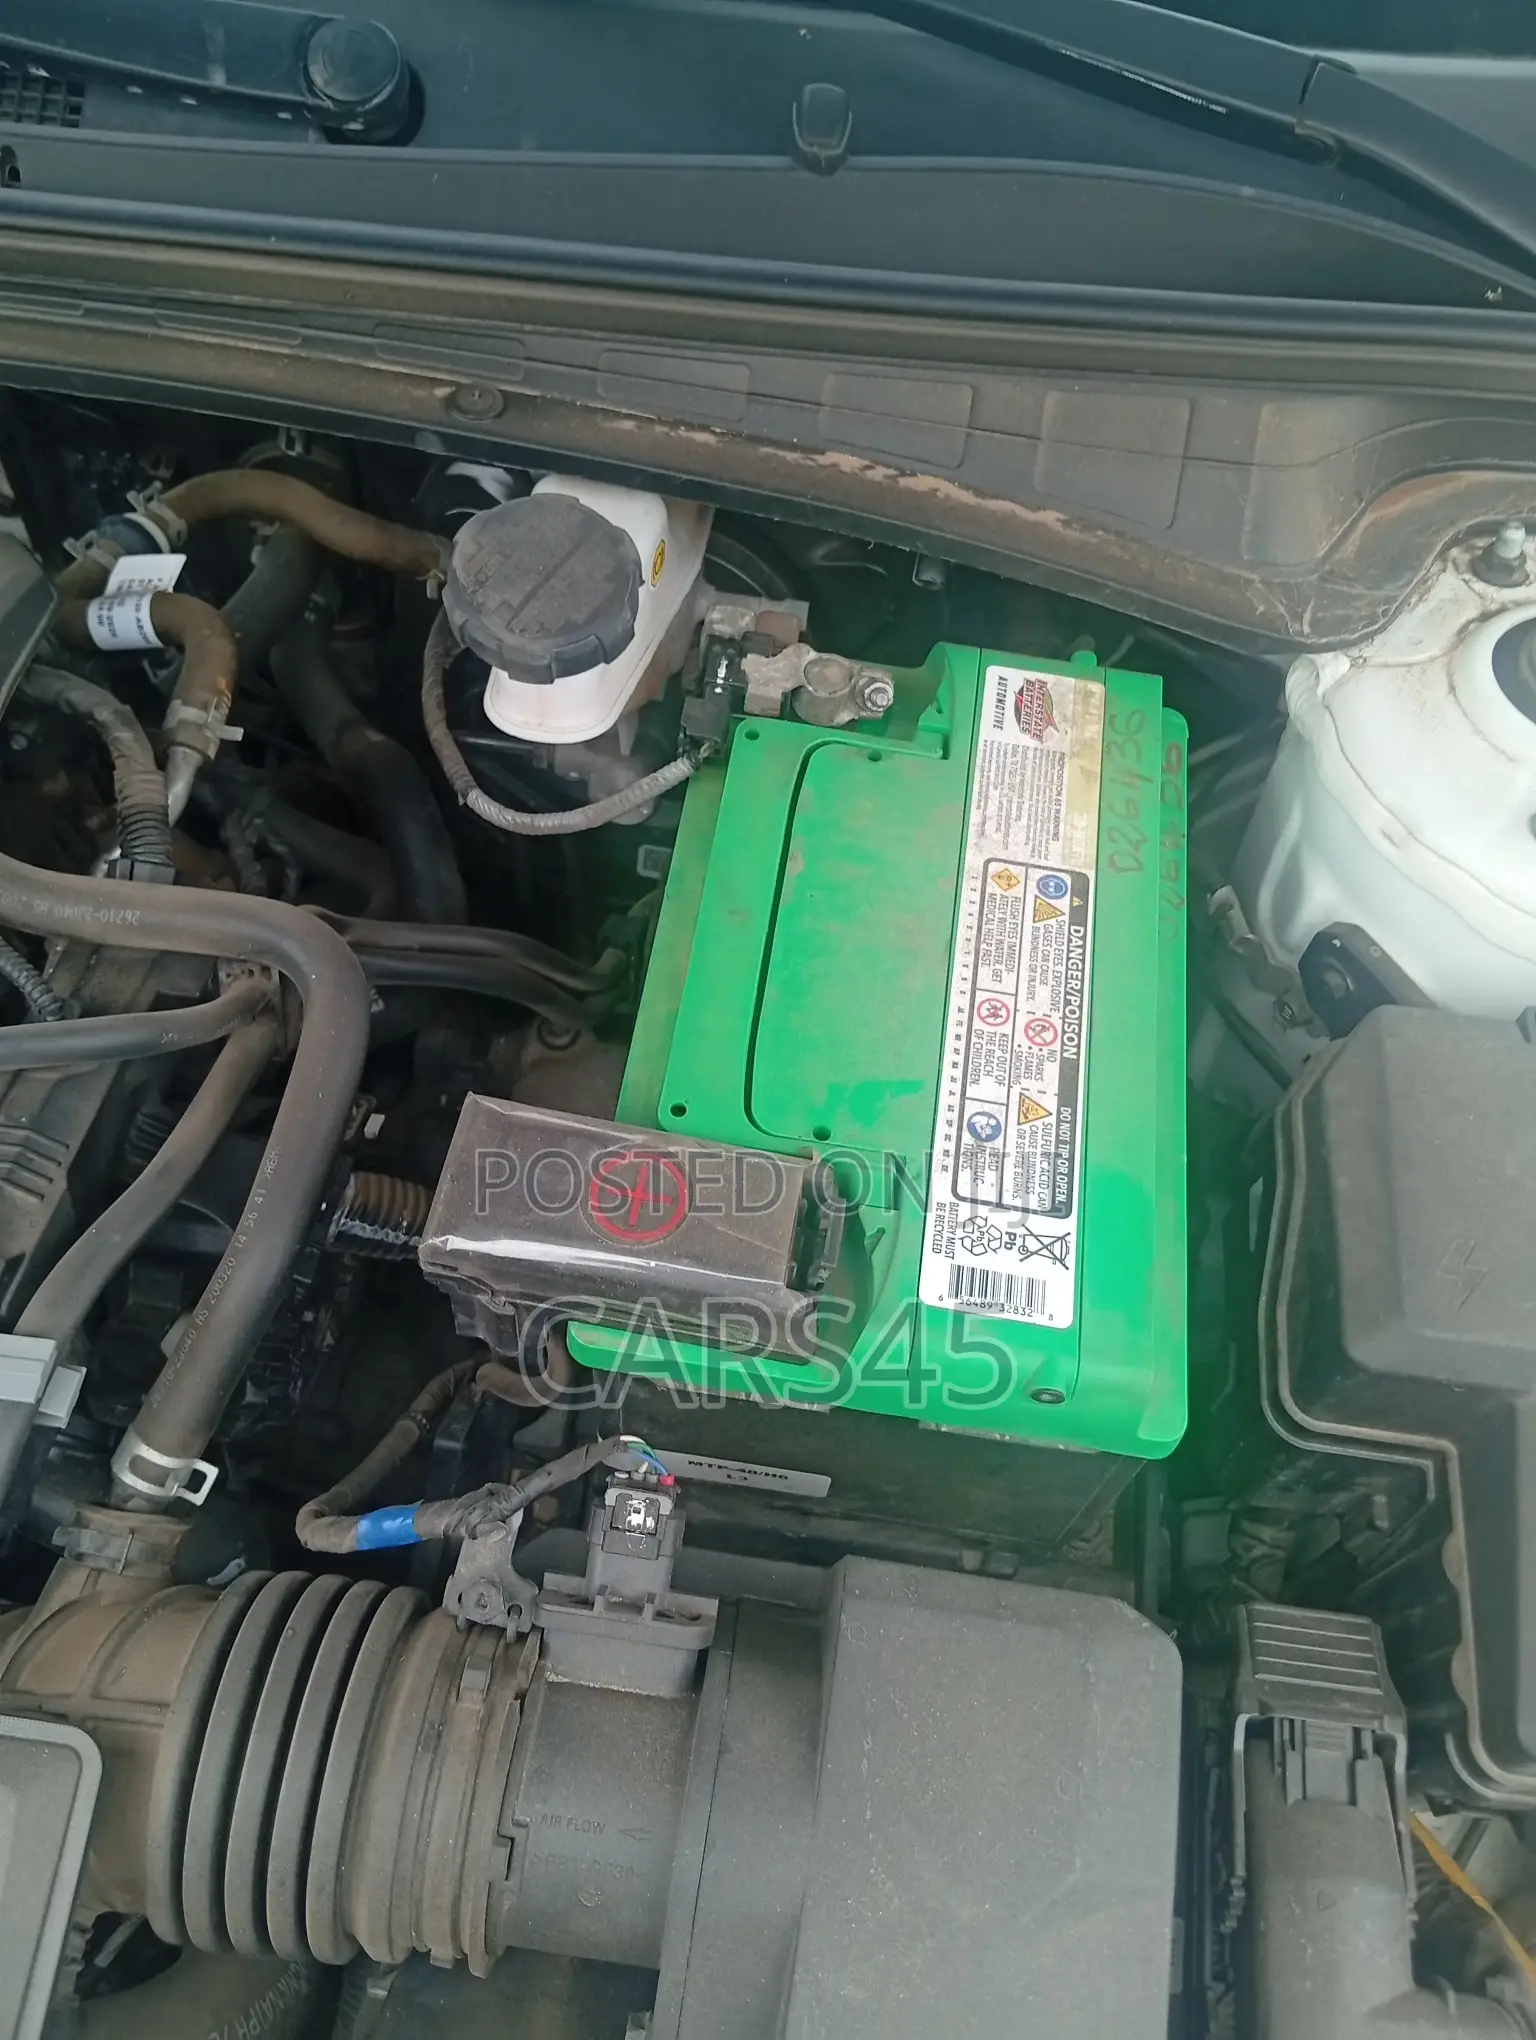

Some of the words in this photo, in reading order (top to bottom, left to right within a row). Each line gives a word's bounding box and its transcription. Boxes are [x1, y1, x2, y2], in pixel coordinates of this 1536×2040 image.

[992, 675, 1008, 730] AUTOMOTIVE
[1020, 679, 1034, 733] BATTERIES
[1031, 679, 1046, 740] INTERSTATE
[984, 892, 997, 926] MEDICAL
[997, 893, 1009, 916] ATELY
[1008, 895, 1021, 920] FLUSH
[982, 926, 994, 947] HELP
[995, 916, 1007, 936] WITH
[1007, 921, 1019, 940] EYES
[1041, 923, 1052, 947] GASES
[1053, 918, 1065, 946] SHIELD
[992, 938, 1005, 966] WATER.
[1028, 925, 1040, 962] BLINDNESS
[980, 948, 992, 968] FAST.
[1004, 941, 1017, 974] IMMEDI-
[1040, 948, 1051, 963] CAN
[1052, 947, 1064, 968] EYES.
[991, 968, 1002, 983] GET
[1027, 963, 1037, 973] OR
[1038, 963, 1050, 986] CAUSE
[1049, 969, 1062, 1013] EXPLOSIVE
[1061, 925, 1084, 1059] DANGER/POISON
[972, 1028, 984, 1041] OF
[984, 1030, 997, 1047] THE
[997, 1032, 1009, 1054] KEEP
[968, 1041, 983, 1088] CHILDREN.
[982, 1047, 995, 1077] REACH
[995, 1055, 1007, 1074] OUT
[1011, 1049, 1023, 1085] SMOKING
[1022, 1051, 1034, 1080] FLAMES
[1046, 1048, 1057, 1063] NO
[1033, 1053, 1045, 1082] SPARKS
[994, 1074, 1005, 1087] OF
[1059, 1106, 1071, 1122] DO
[1015, 1128, 1026, 1141] OR
[1027, 1124, 1039, 1150] CAUSE
[1058, 1122, 1070, 1141] NOT
[1013, 1141, 1025, 1170] SEVERE
[1038, 1121, 1053, 1168] SULFURIC
[1057, 1142, 1069, 1159] TIP
[960, 1142, 974, 1173] TIONS.
[1056, 1159, 1068, 1173] OR
[1024, 1150, 1037, 1195] BLINDNESS
[1037, 1168, 1050, 1190] ACID
[1011, 1170, 1023, 1201] BURNS.
[1054, 1173, 1067, 1205] OPEN.
[935, 1201, 946, 1214] BE
[1036, 1191, 1048, 1209] CAN
[945, 1201, 959, 1235] BATTERY
[930, 1213, 945, 1254] RECYCLED
[975, 1230, 984, 1242] Pb
[1003, 1230, 1016, 1251] Pb
[943, 1235, 956, 1260] MUST
[959, 1296, 993, 1310] 56489
[999, 1304, 1034, 1317] 32832
[539, 1813, 562, 1829] AIR
[566, 1816, 606, 1836] FLOW
